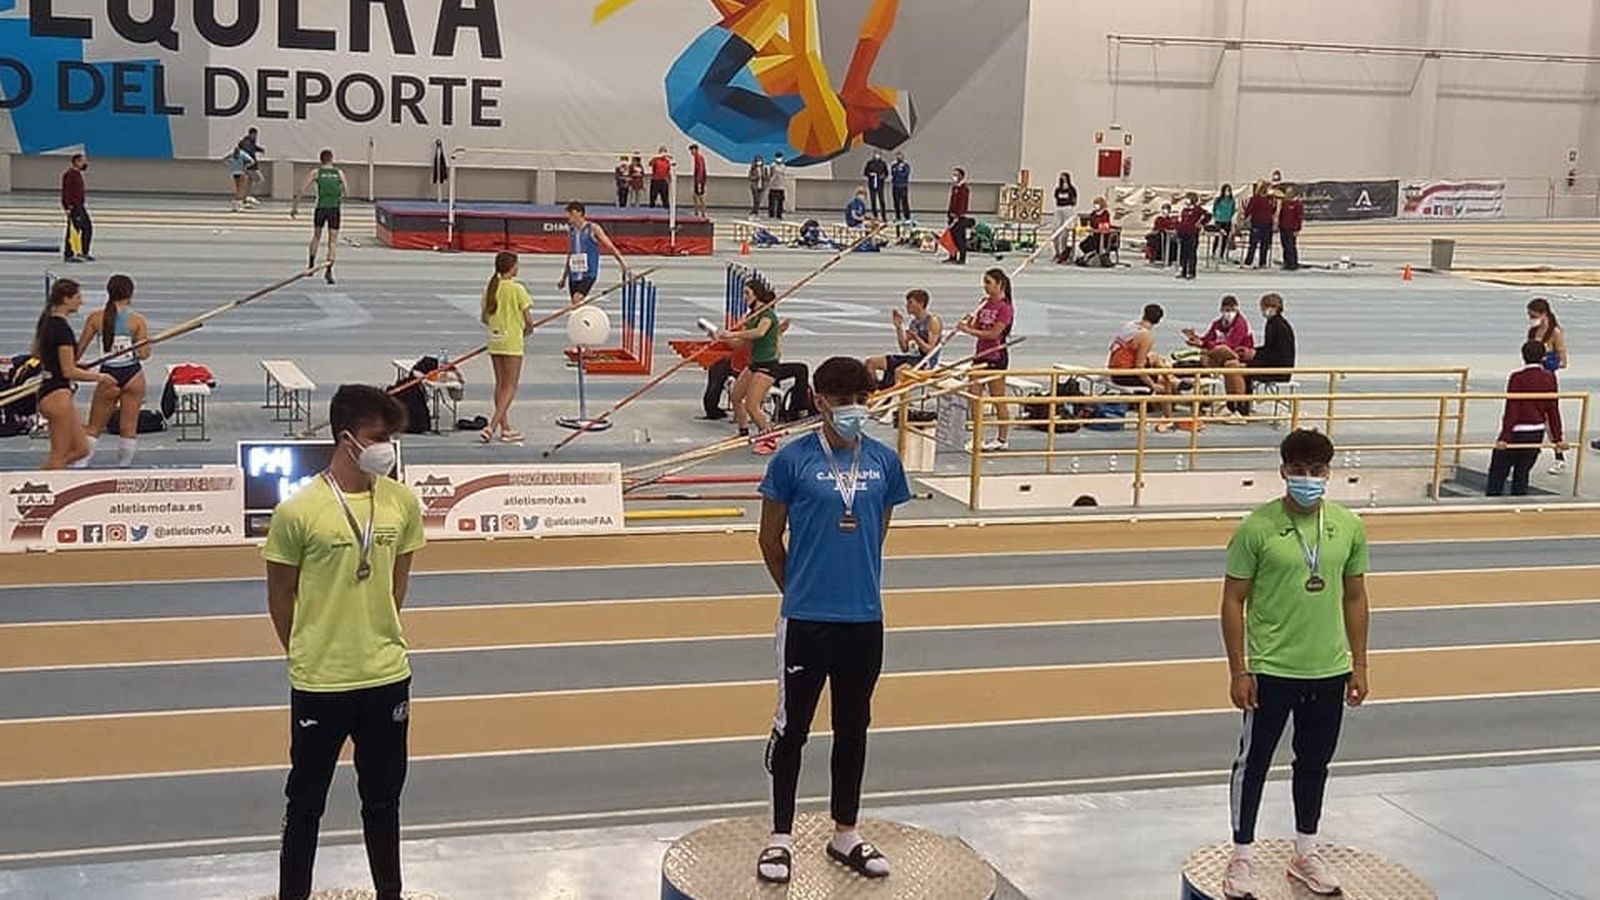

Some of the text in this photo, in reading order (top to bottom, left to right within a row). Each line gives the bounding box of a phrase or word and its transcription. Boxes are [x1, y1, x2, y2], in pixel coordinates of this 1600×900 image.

[57, 61, 185, 116] DEL
[204, 67, 503, 127] DEPORTE
[503, 495, 587, 506] atletismofaa.es
[109, 502, 203, 514] atletismofaa.es
[543, 516, 613, 528] @atletismoFAA
[153, 525, 232, 538] @atletismoFAA
